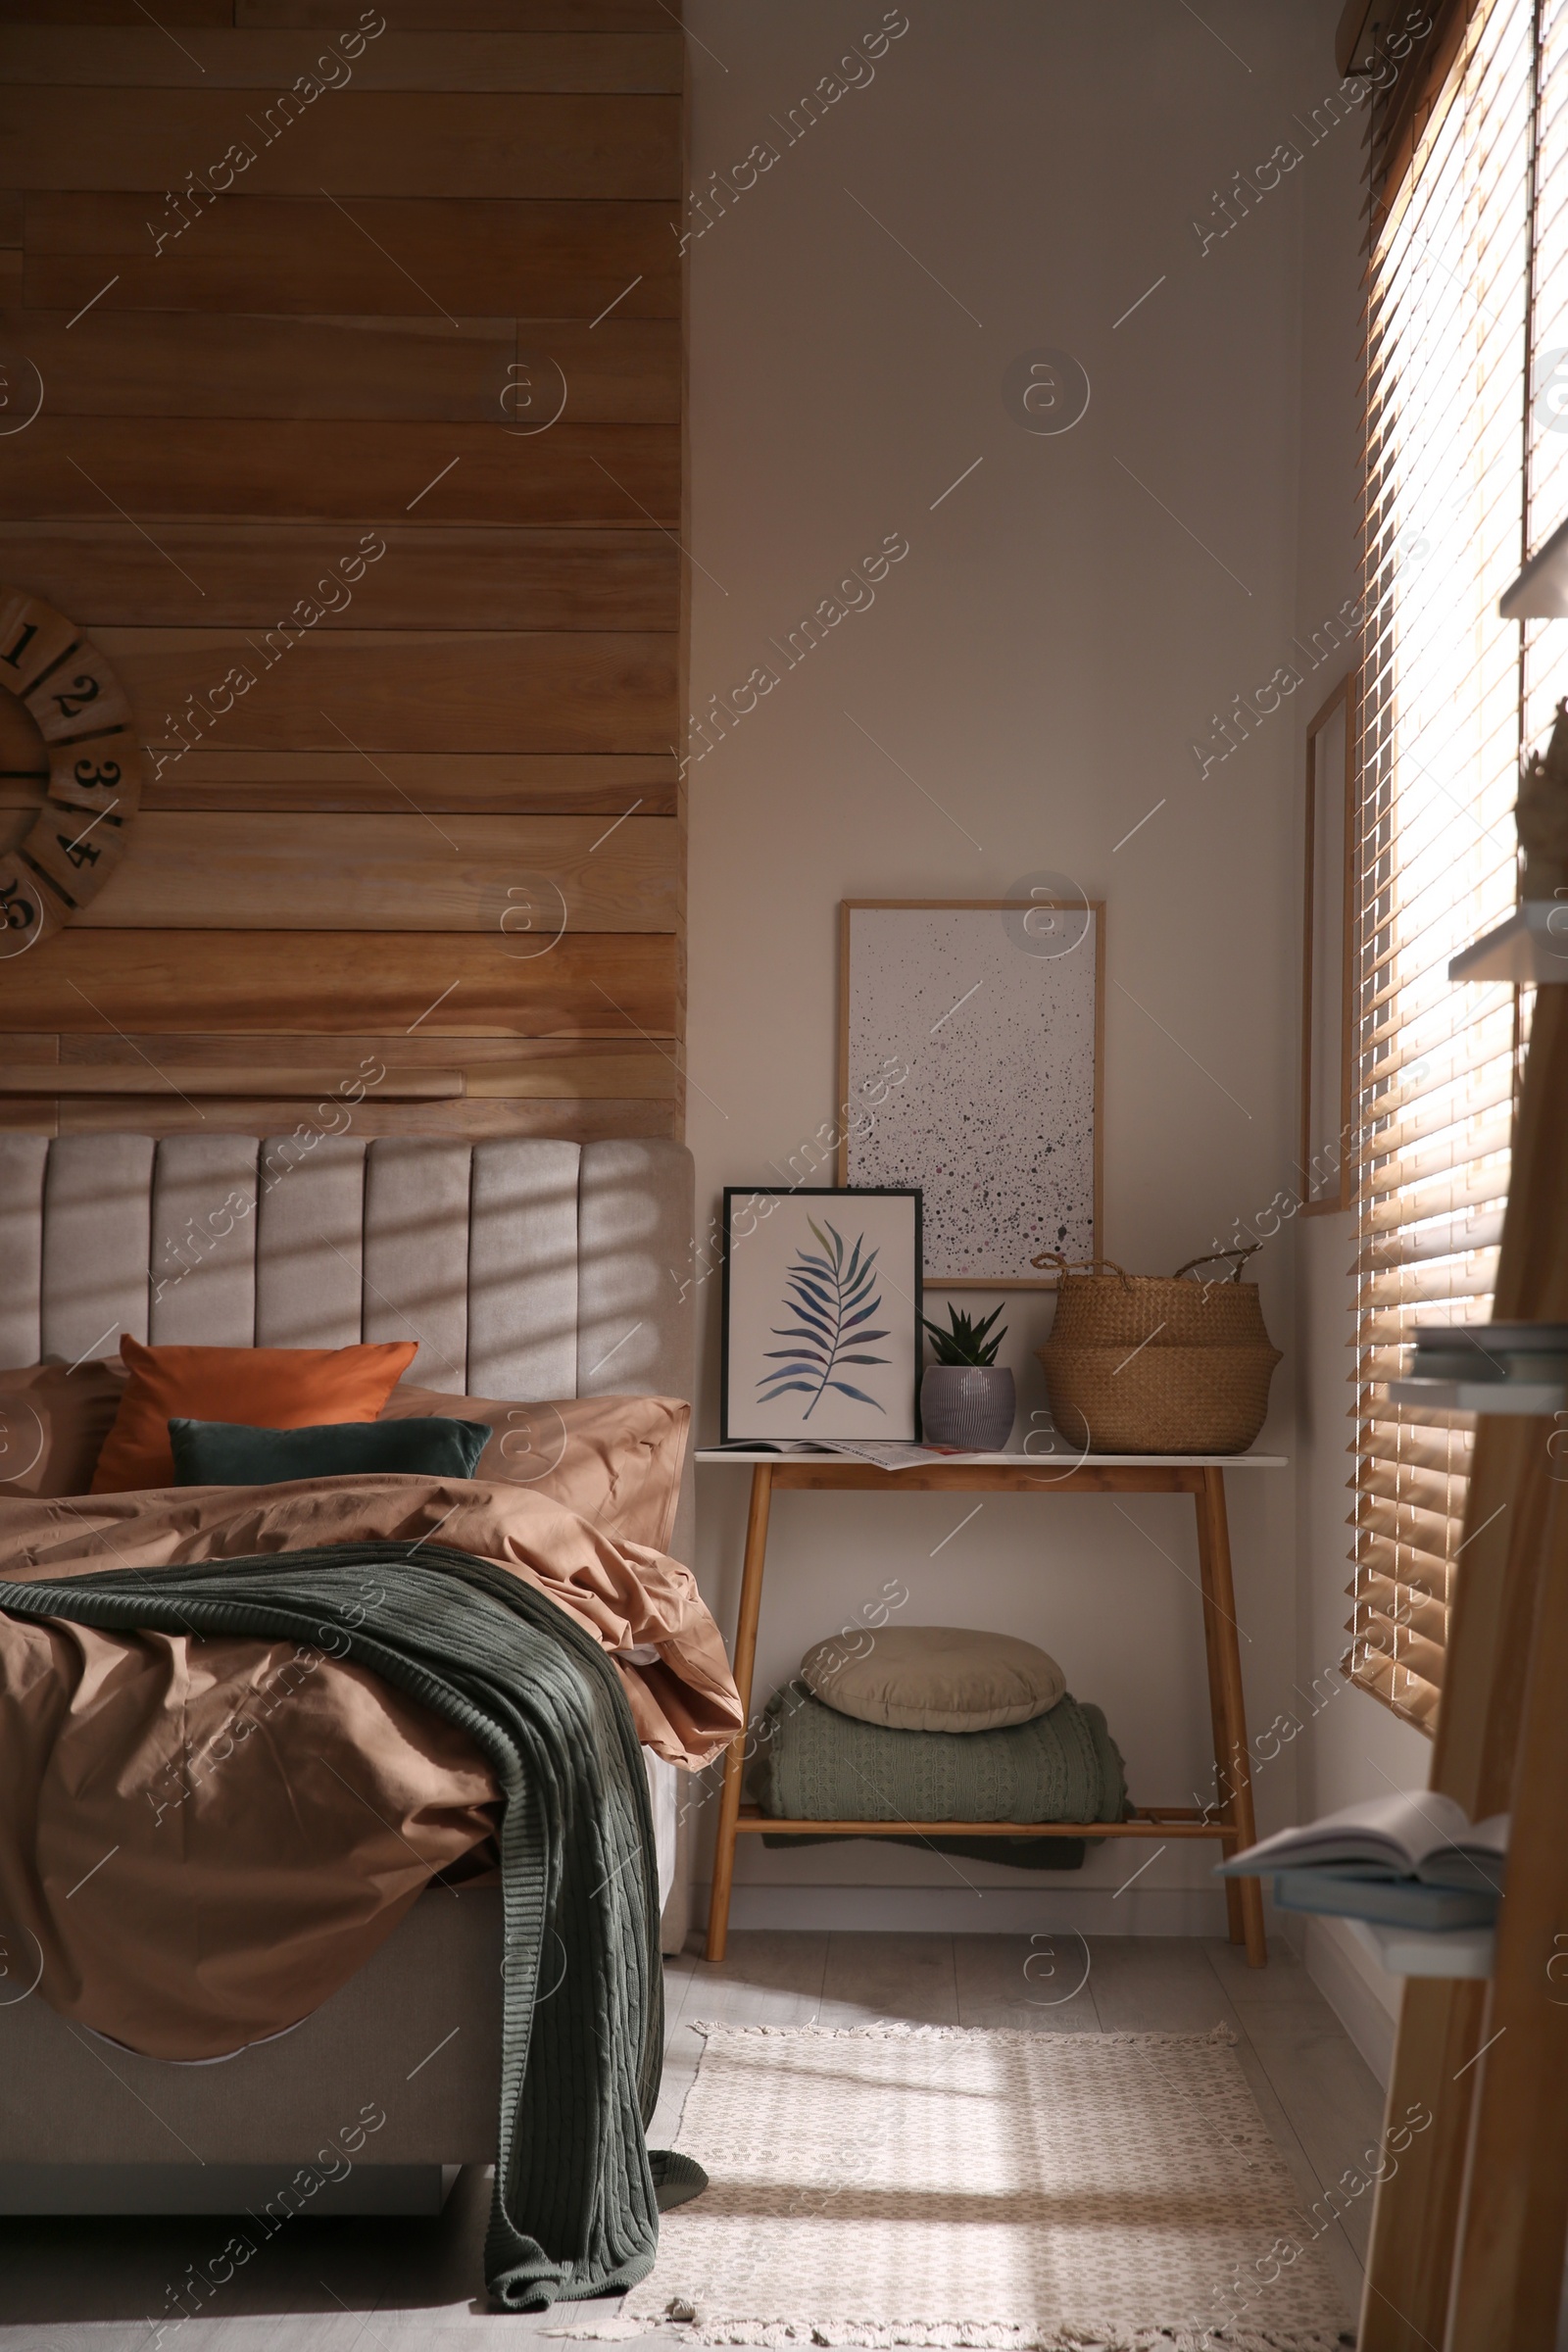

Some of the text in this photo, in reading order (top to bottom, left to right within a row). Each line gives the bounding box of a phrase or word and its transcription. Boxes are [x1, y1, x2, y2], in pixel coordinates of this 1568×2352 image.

[1, 622, 38, 669] 1
[52, 674, 99, 717] 2
[74, 760, 122, 788] 3
[56, 834, 102, 869] 4
[0, 878, 34, 929] 5
